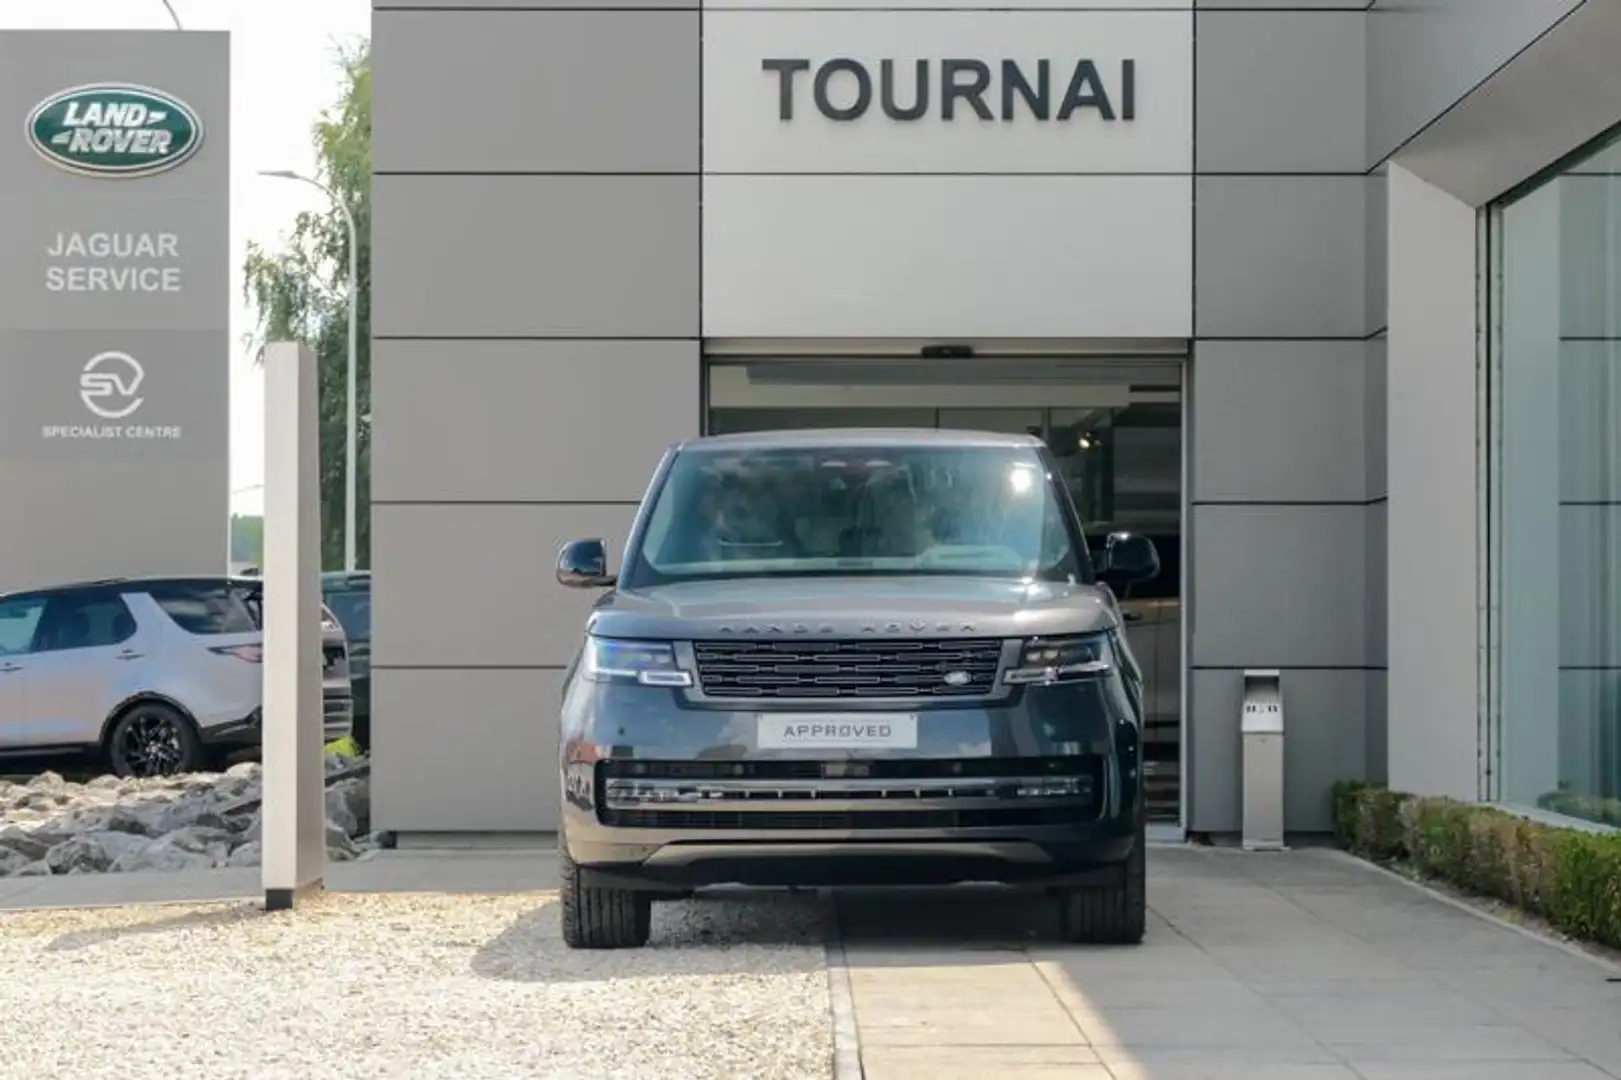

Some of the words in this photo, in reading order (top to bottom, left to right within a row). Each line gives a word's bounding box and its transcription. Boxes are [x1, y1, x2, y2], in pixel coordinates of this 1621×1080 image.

[762, 58, 1135, 121] TOURNAI
[63, 102, 147, 127] LAND
[68, 128, 173, 154] ROVER
[48, 232, 178, 257] JAGUAR
[45, 267, 181, 291] SERVICE
[42, 425, 122, 438] SPECIALIST
[126, 425, 182, 438] CENTRE
[783, 723, 892, 738] APPROVED
